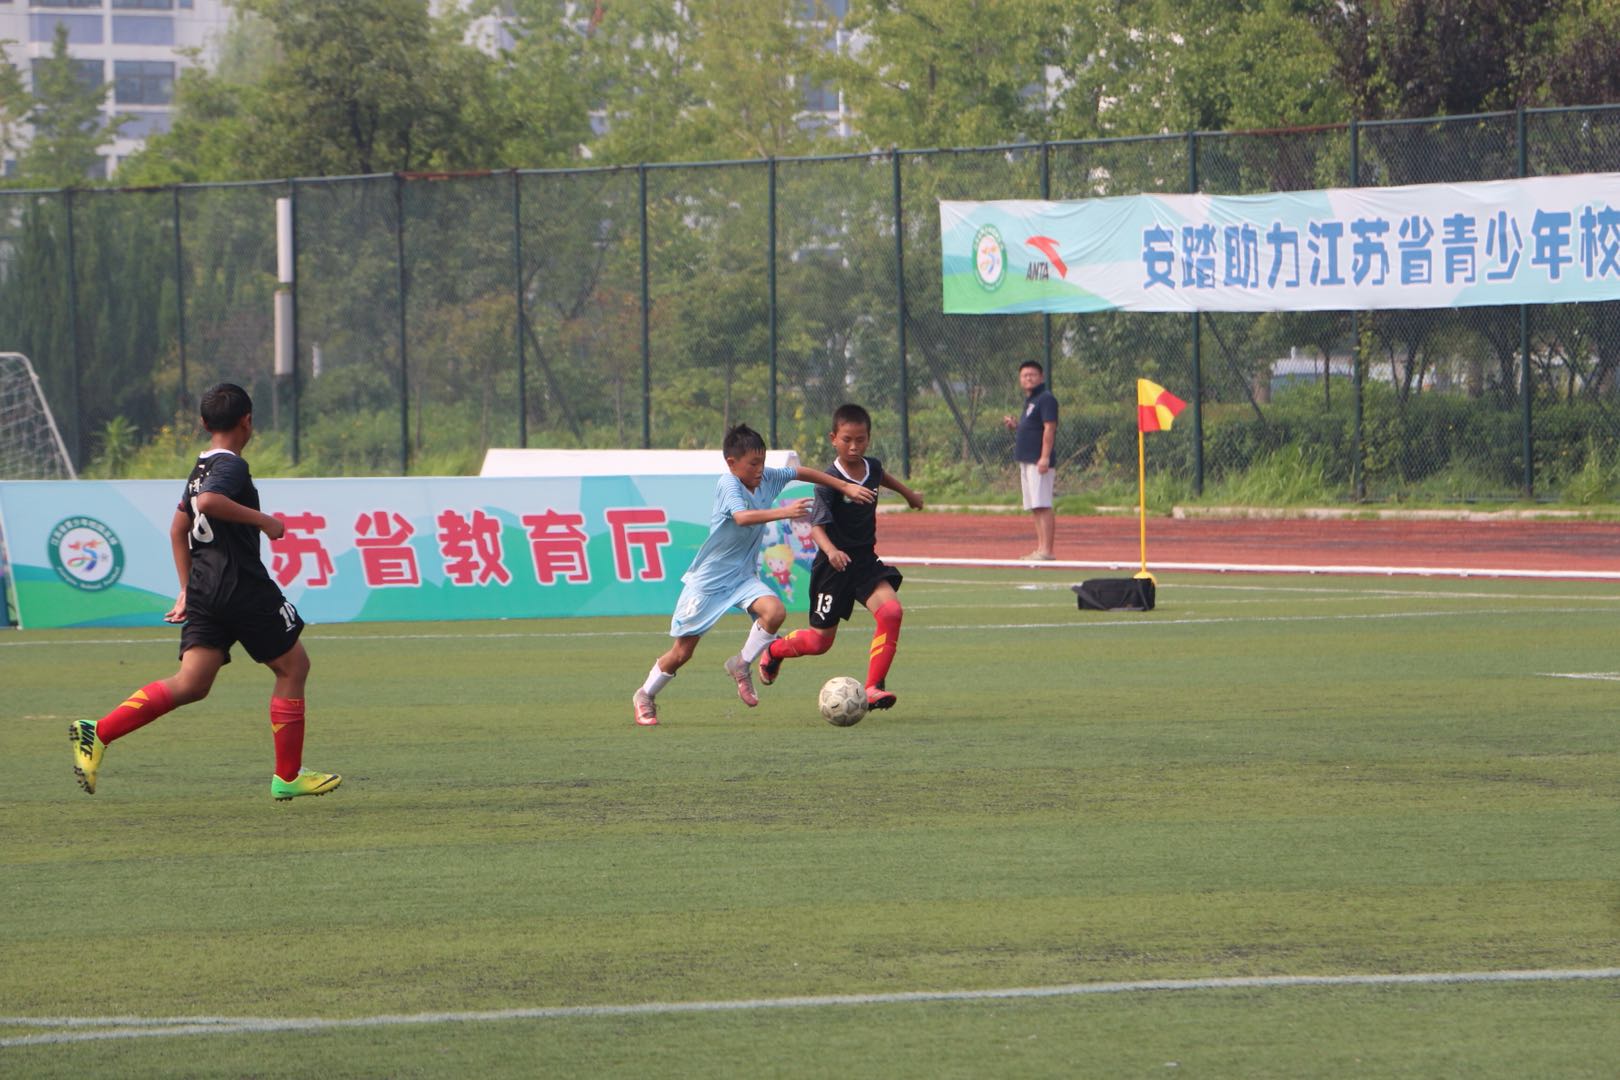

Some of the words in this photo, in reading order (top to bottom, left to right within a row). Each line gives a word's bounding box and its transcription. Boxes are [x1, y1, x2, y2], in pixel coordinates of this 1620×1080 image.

[1142, 205, 1620, 289] 安踏助力江苏省青少年校
[1026, 262, 1049, 280] ANTA
[816, 592, 833, 613] 13
[79, 720, 95, 760] NIKE
